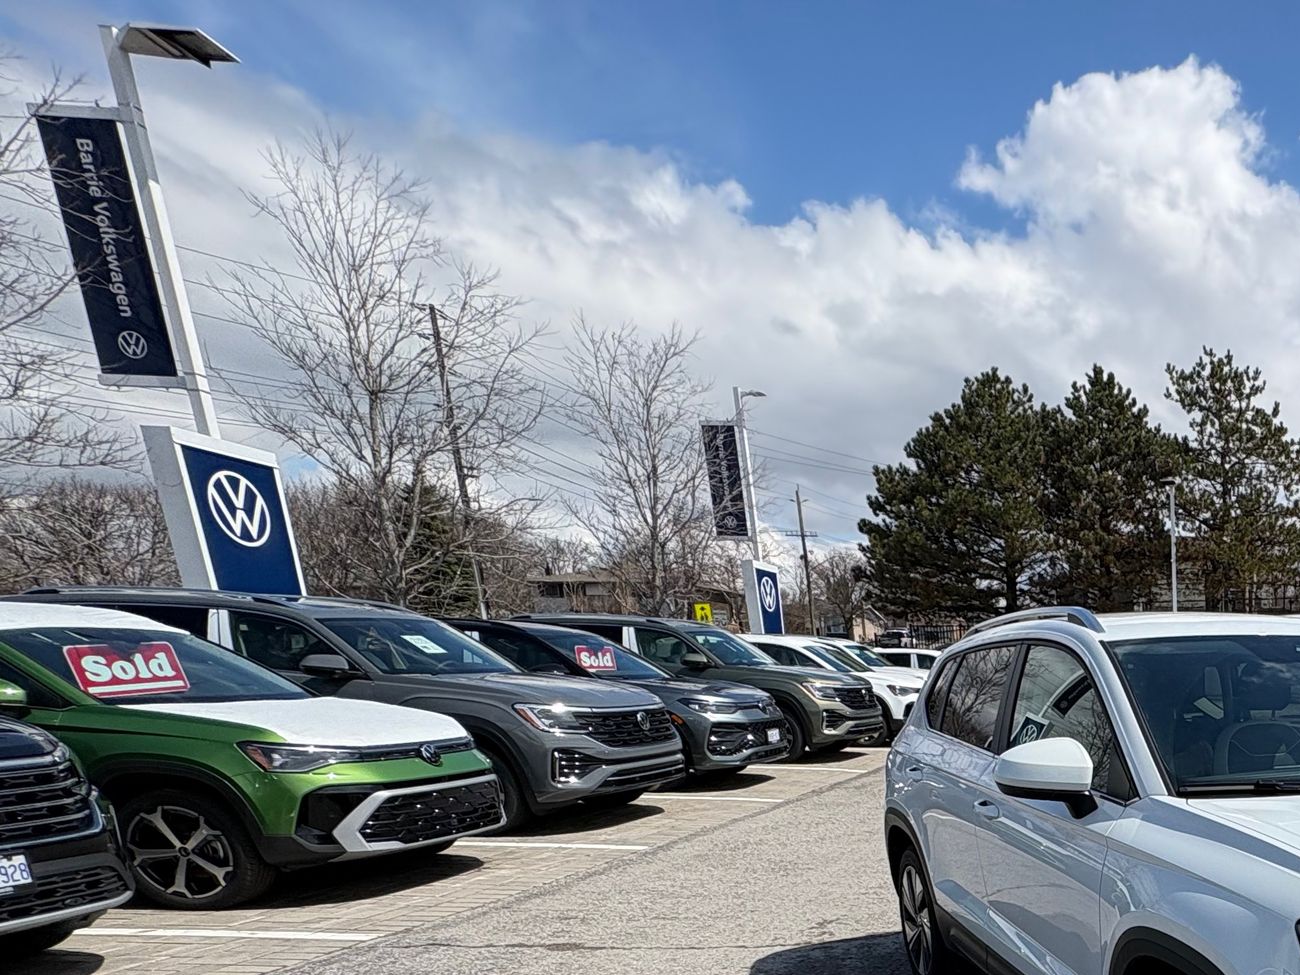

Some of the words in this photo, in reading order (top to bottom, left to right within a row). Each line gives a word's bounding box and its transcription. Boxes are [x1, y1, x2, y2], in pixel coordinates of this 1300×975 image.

[76, 138, 102, 198] Barrie
[93, 202, 132, 317] Volkswagen
[81, 652, 176, 682] Sold
[580, 651, 614, 667] Sold
[0, 862, 30, 884] 928
